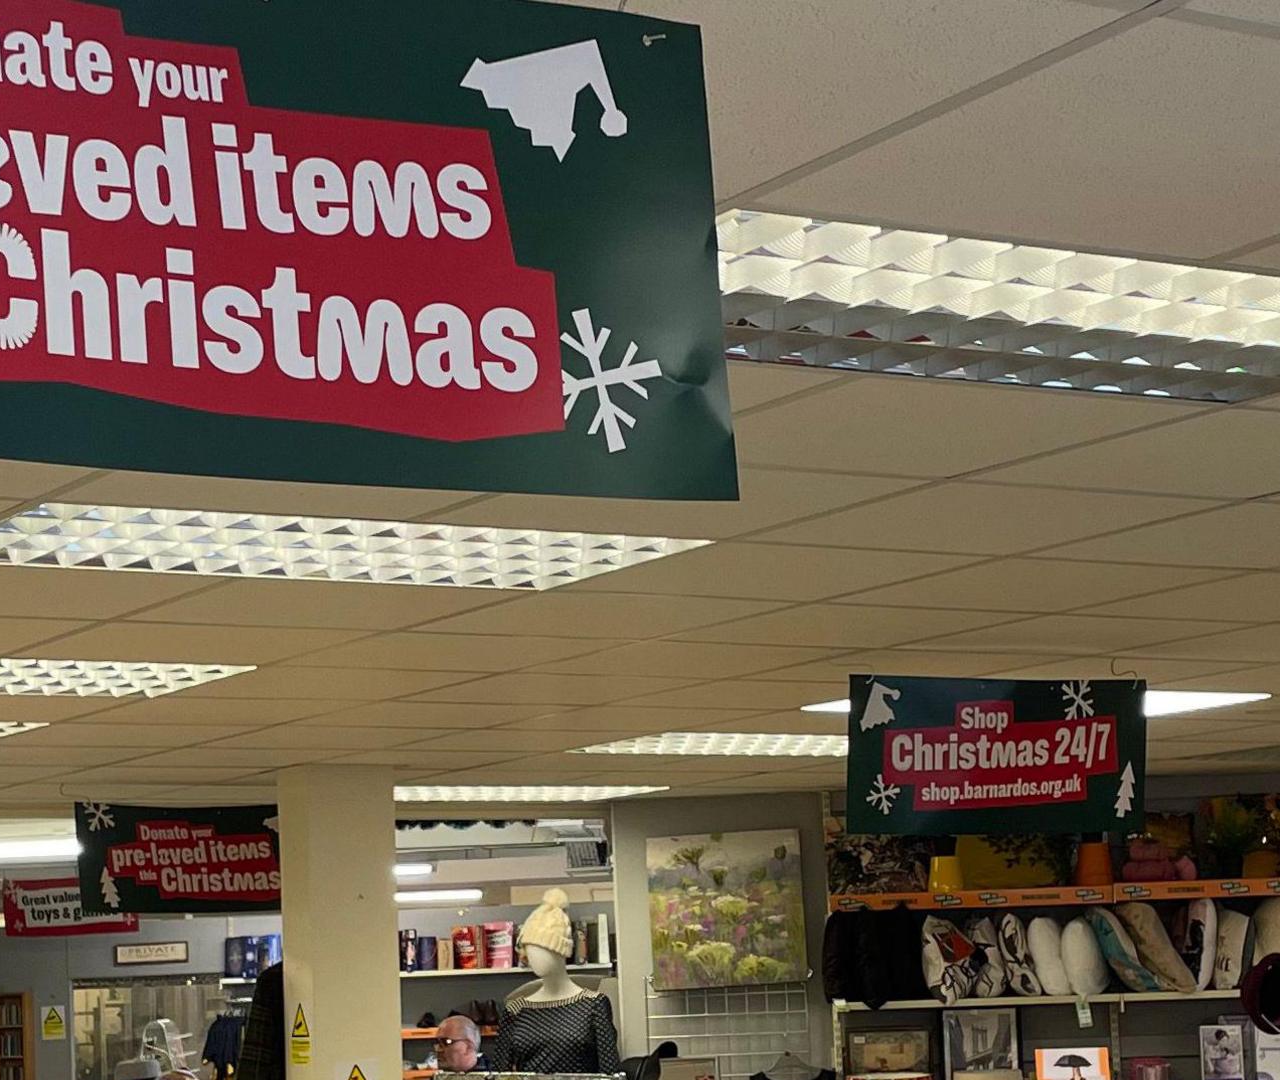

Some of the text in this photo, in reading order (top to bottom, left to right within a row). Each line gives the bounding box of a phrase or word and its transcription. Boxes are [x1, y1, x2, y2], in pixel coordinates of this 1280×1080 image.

[129, 54, 227, 108] your
[212, 122, 490, 240] items
[961, 706, 1009, 734] Shop
[891, 723, 1112, 773] Christmas 24/7
[921, 774, 1082, 804] shop.barnardos.org.uk
[140, 824, 213, 841] Donate your
[111, 840, 271, 873] pre-loved items
[139, 867, 281, 893] this Christmas
[22, 894, 51, 907] Great
[31, 907, 60, 923] toys
[63, 908, 71, 920] &
